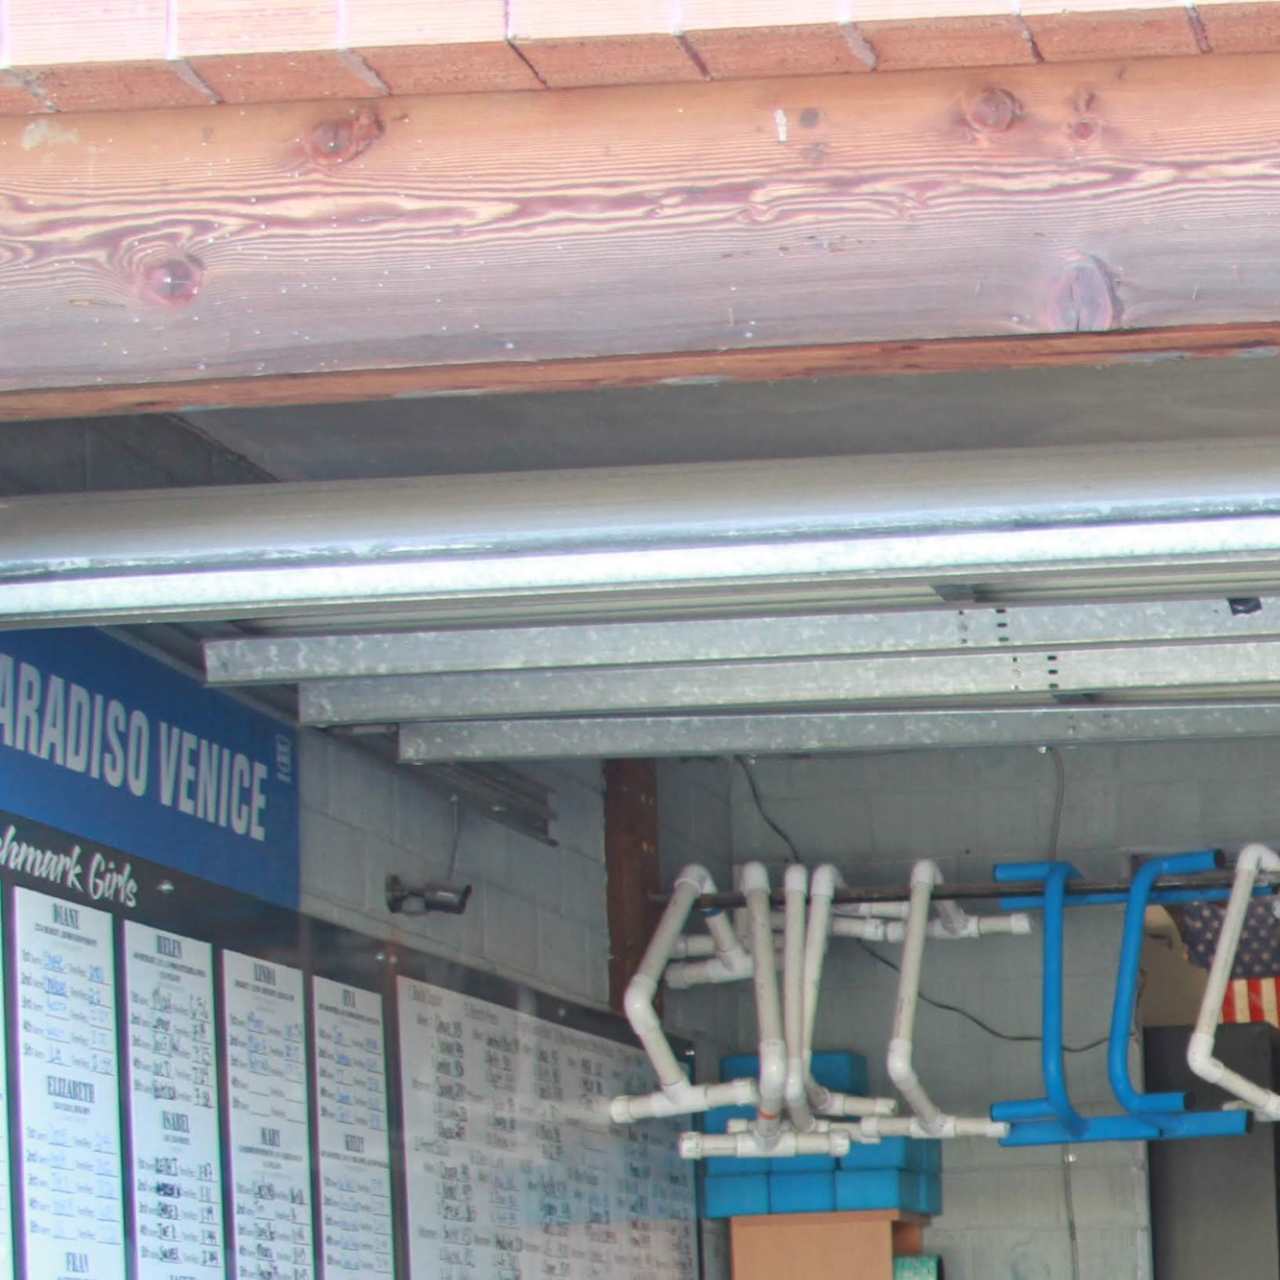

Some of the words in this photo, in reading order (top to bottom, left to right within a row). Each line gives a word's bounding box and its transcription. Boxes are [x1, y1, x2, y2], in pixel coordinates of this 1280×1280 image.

[159, 720, 268, 842] VENICE
[0, 824, 84, 893] hmark
[88, 852, 138, 908] Girls
